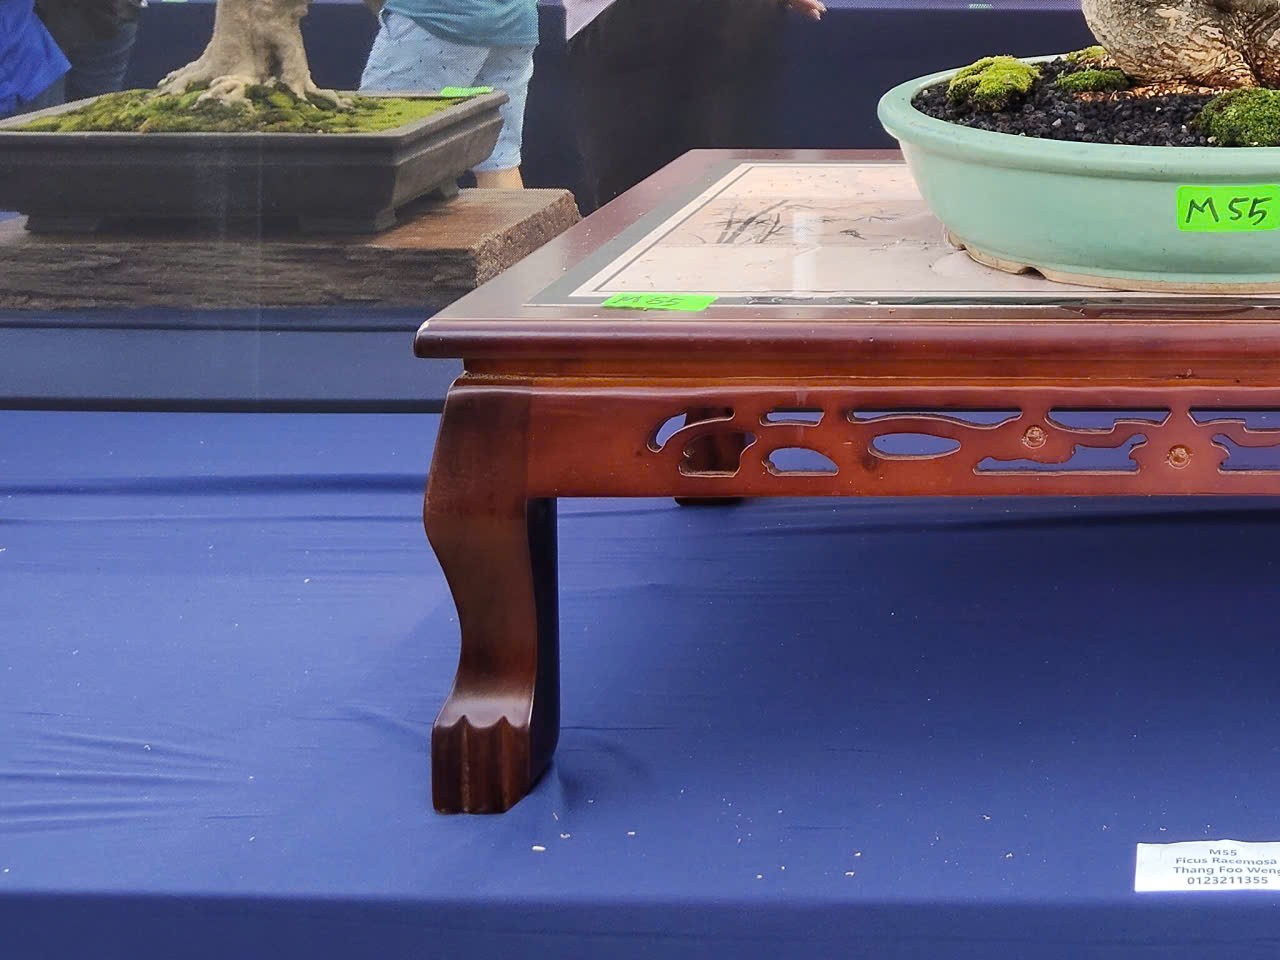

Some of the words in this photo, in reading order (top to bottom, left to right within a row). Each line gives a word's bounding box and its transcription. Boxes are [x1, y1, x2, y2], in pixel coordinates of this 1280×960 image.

[1209, 848, 1238, 857] M55
[1212, 857, 1278, 865] Racemosa
[1174, 866, 1215, 875] Thang
[1219, 866, 1244, 874] Foo
[1187, 876, 1269, 885] 0123211355
